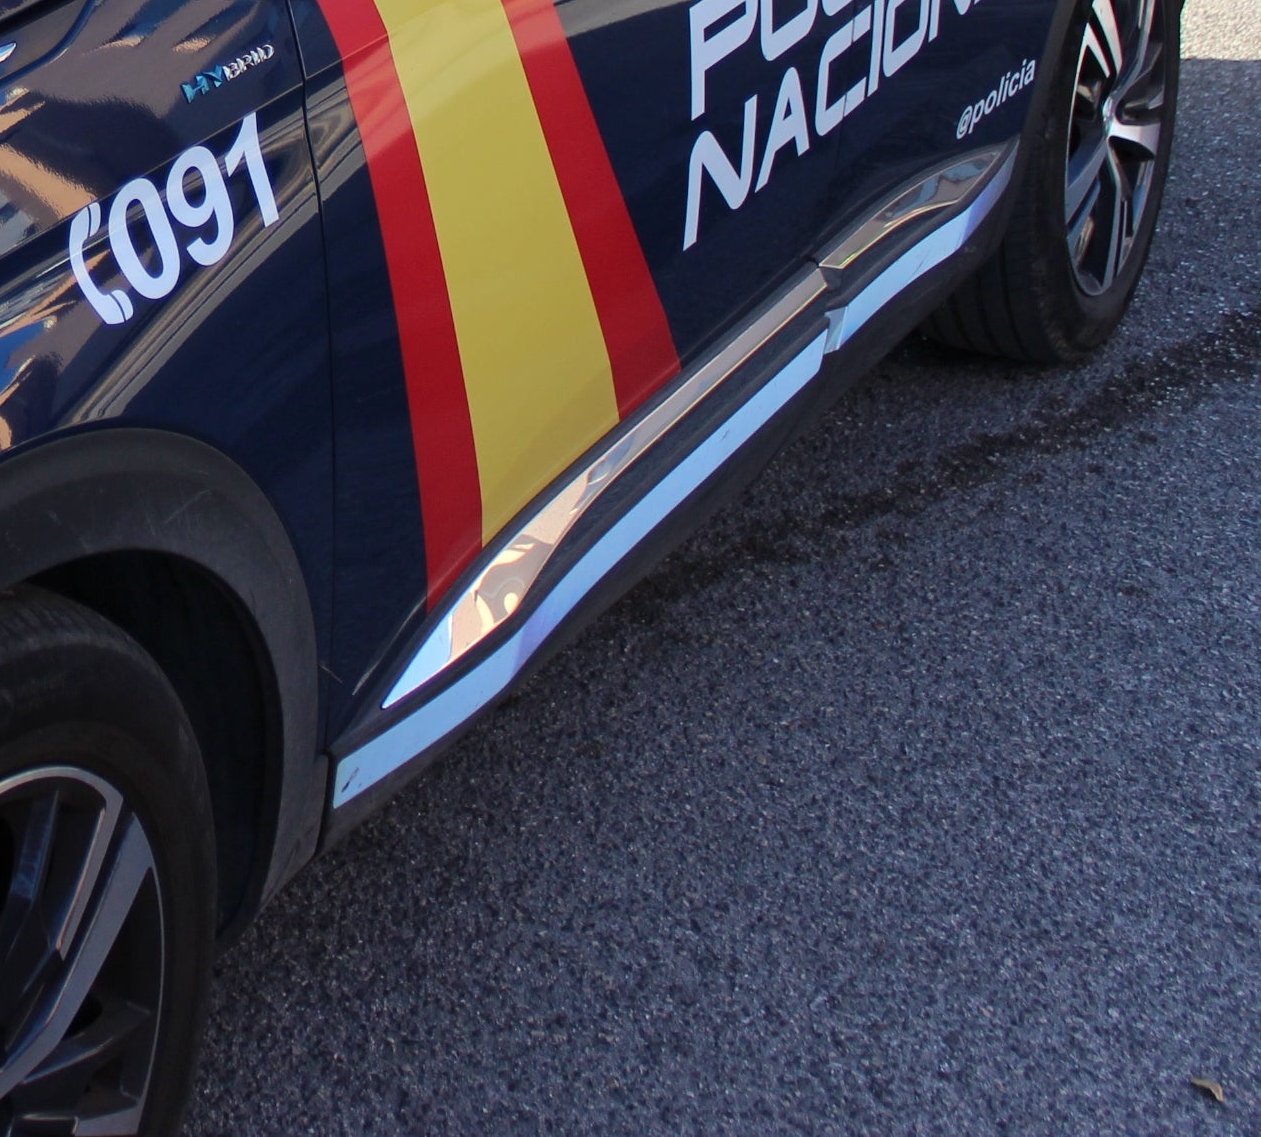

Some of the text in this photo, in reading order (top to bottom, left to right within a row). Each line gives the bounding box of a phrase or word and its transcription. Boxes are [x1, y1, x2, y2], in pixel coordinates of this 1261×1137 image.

[181, 44, 275, 104] HYBRID
[956, 58, 1036, 140] @policia
[108, 112, 280, 300] 091
